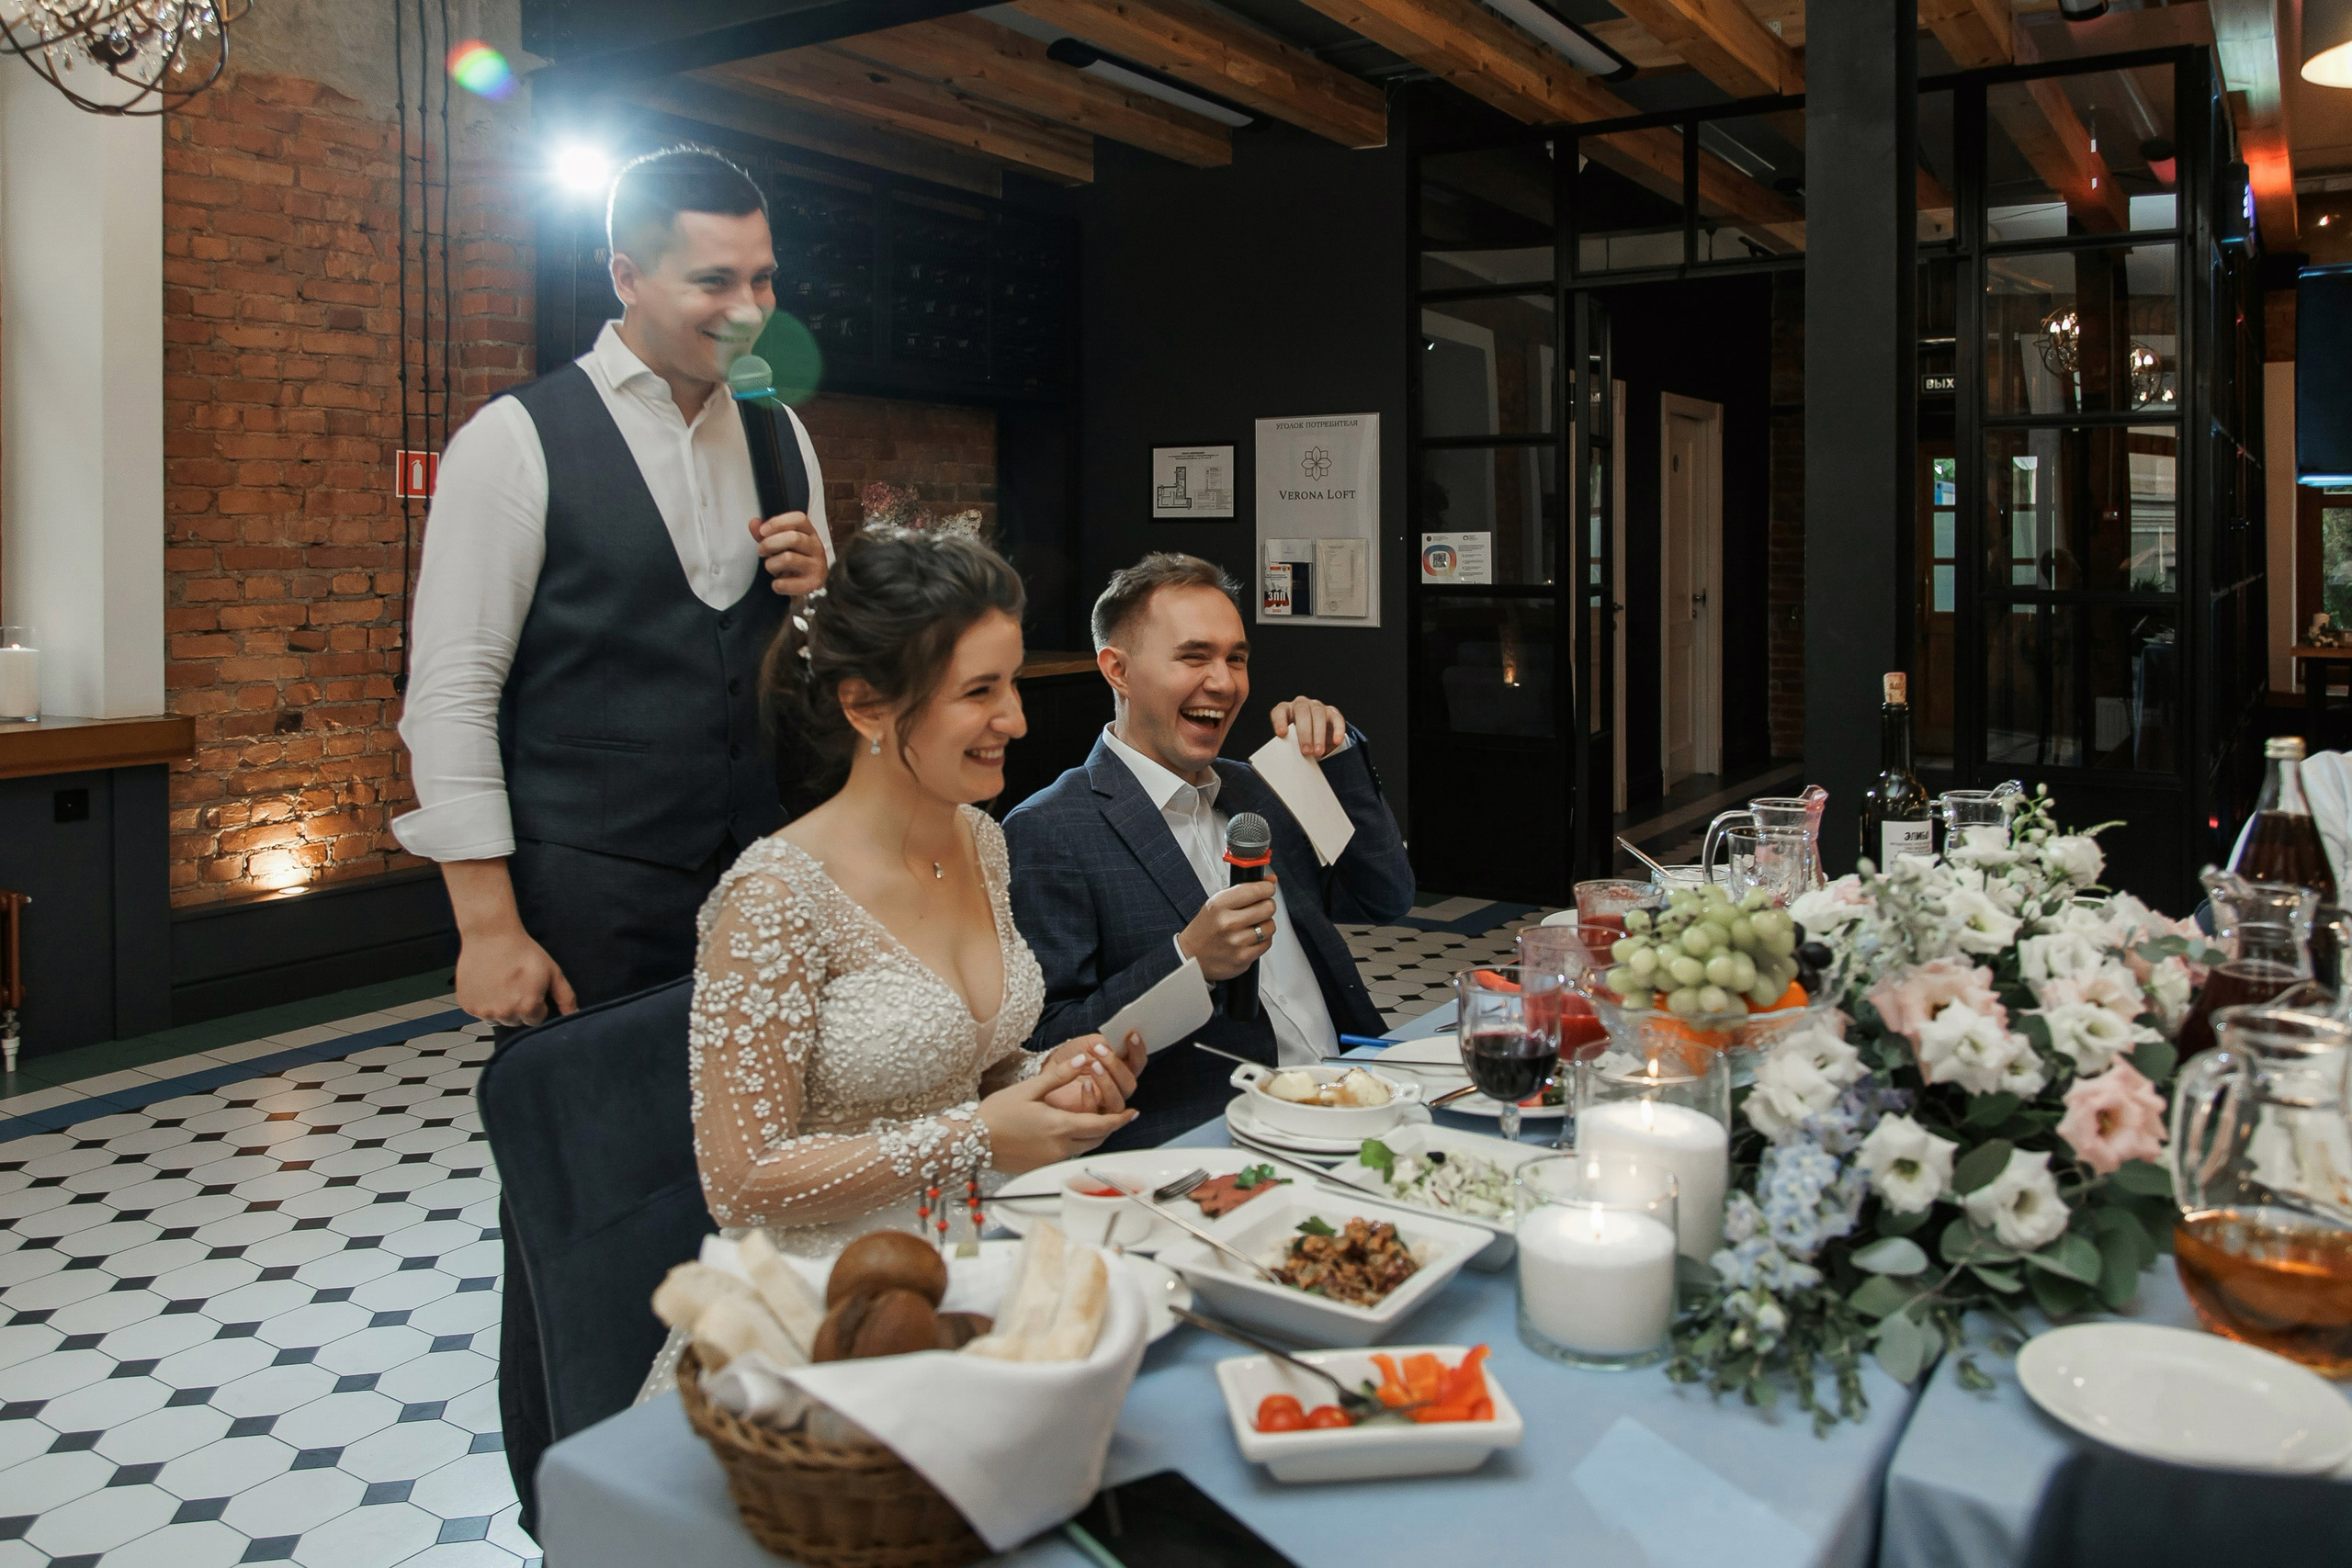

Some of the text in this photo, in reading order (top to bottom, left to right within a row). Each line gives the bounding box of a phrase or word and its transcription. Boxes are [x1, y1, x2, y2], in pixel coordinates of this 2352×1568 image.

[1926, 378, 1955, 389] ВЫХ
[1276, 420, 1358, 430] УГОЛОК ПОТРЕБИТЕЛЯ
[1268, 592, 1286, 601] ЗПП
